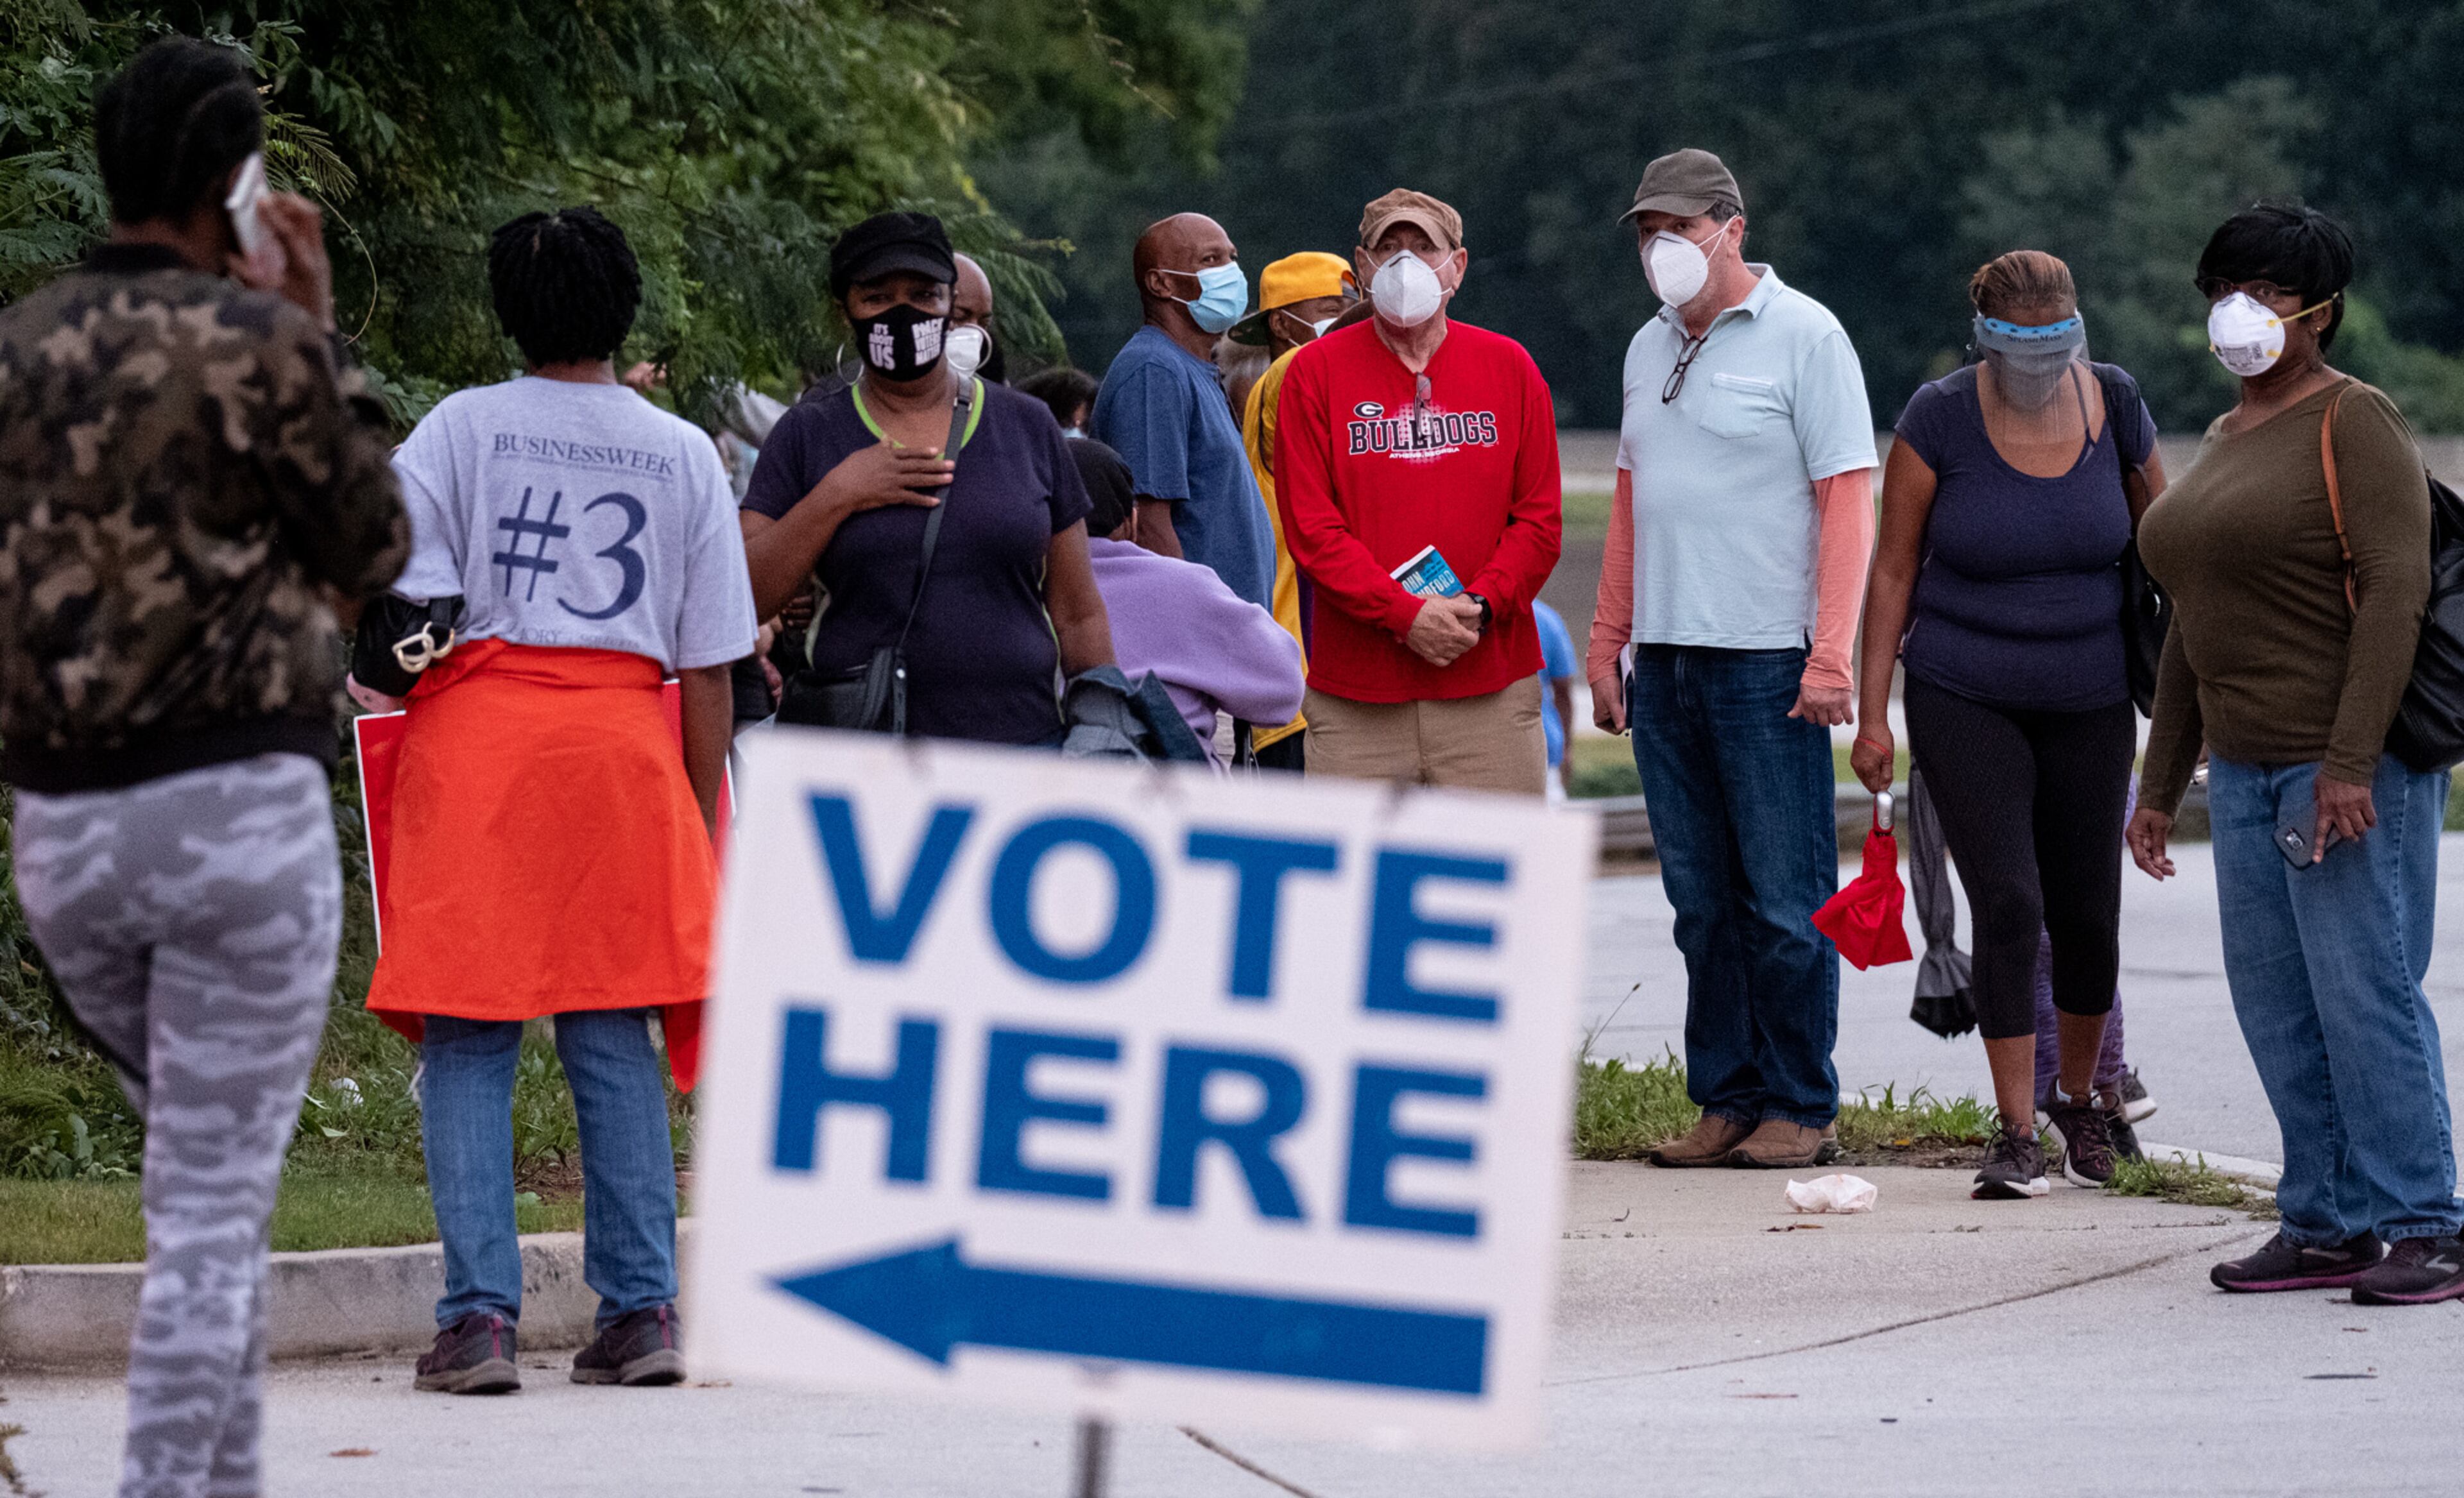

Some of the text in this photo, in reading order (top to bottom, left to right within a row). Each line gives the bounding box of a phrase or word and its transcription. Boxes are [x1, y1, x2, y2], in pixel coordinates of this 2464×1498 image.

[869, 343, 895, 370] US
[493, 433, 675, 475] BUSINESSWEEK
[1348, 411, 1498, 454] BULLDOGS
[492, 486, 647, 620] #3
[1401, 571, 1426, 593] OHN
[807, 791, 1516, 1025] VOTE
[769, 1005, 1491, 1239] HERE
